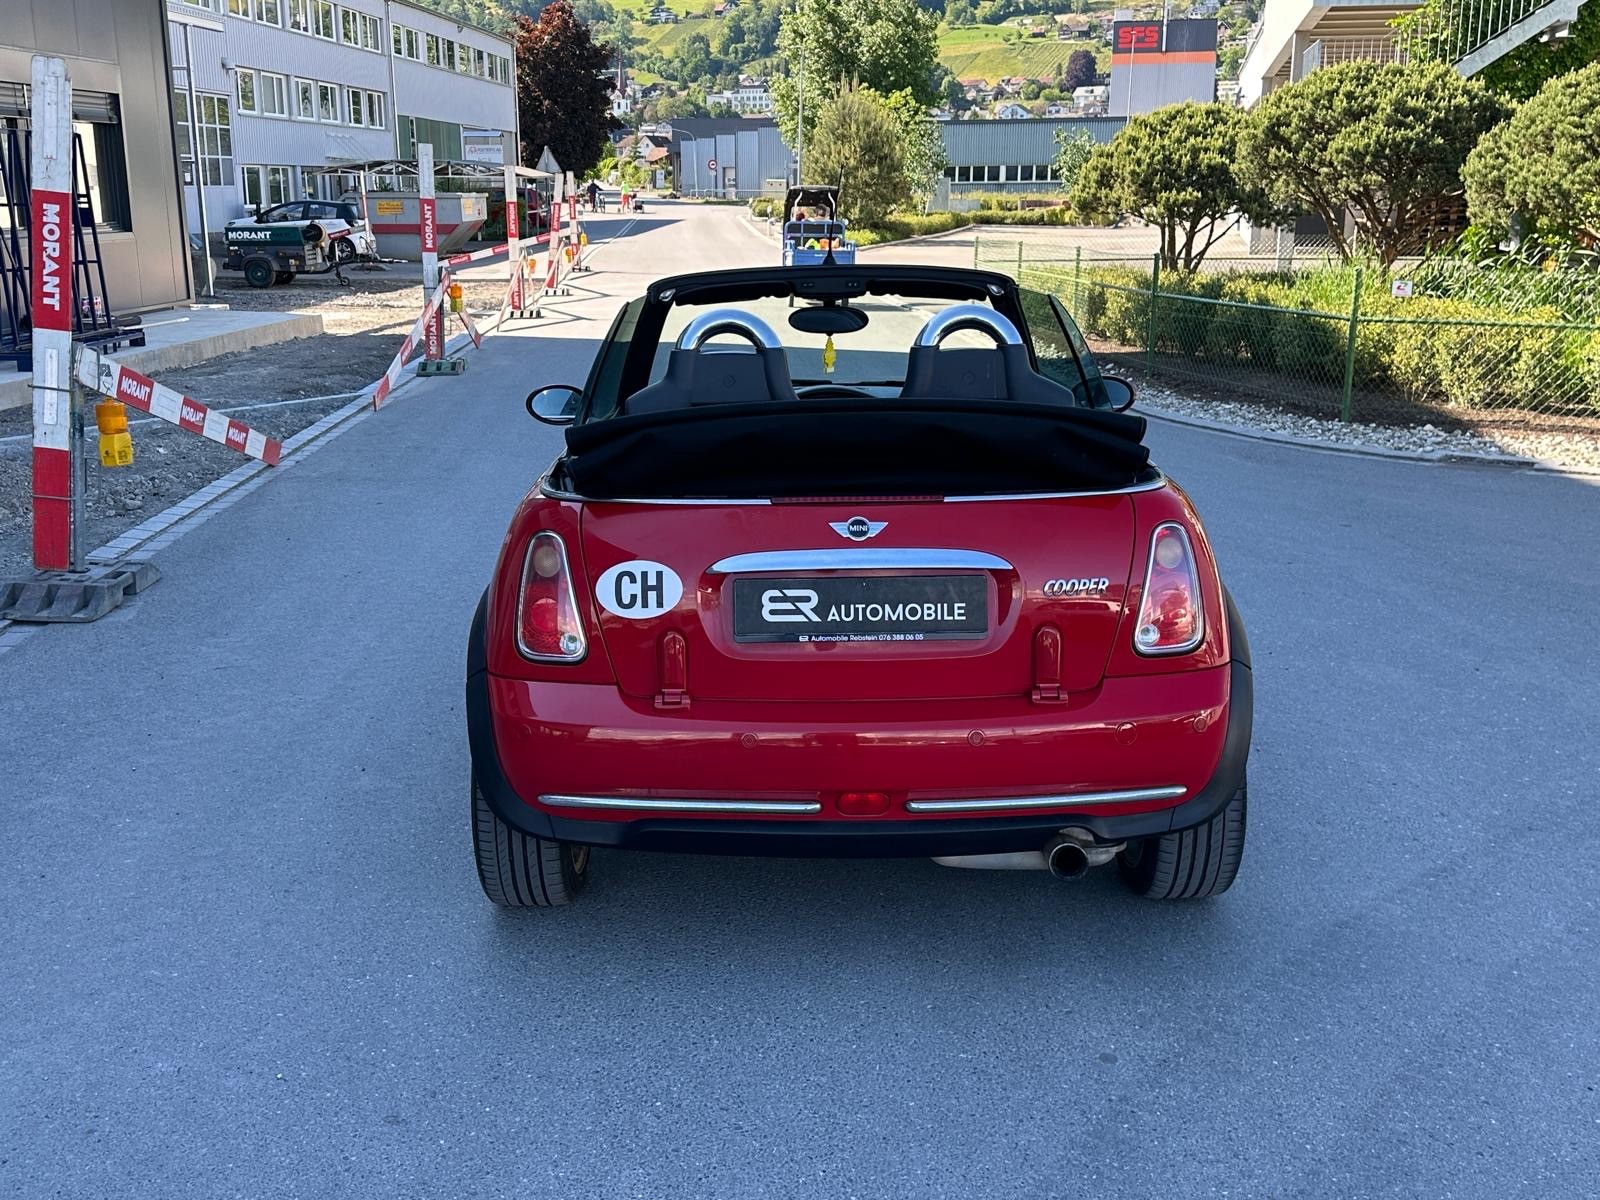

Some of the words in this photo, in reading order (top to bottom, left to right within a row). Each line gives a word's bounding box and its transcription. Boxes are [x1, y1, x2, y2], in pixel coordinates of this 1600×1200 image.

[1118, 26, 1159, 44] SFS
[228, 231, 271, 240] MORANT
[424, 203, 433, 249] MORANT
[42, 203, 60, 311] MORANT
[120, 375, 151, 402] MORANT
[181, 404, 204, 424] MORANT
[228, 427, 248, 445] MORANT
[614, 570, 664, 609] CH
[1043, 577, 1109, 596] COOPER
[827, 603, 966, 621] AUTOMOBILE
[811, 634, 848, 642] Automobile
[915, 633, 924, 641] 05
